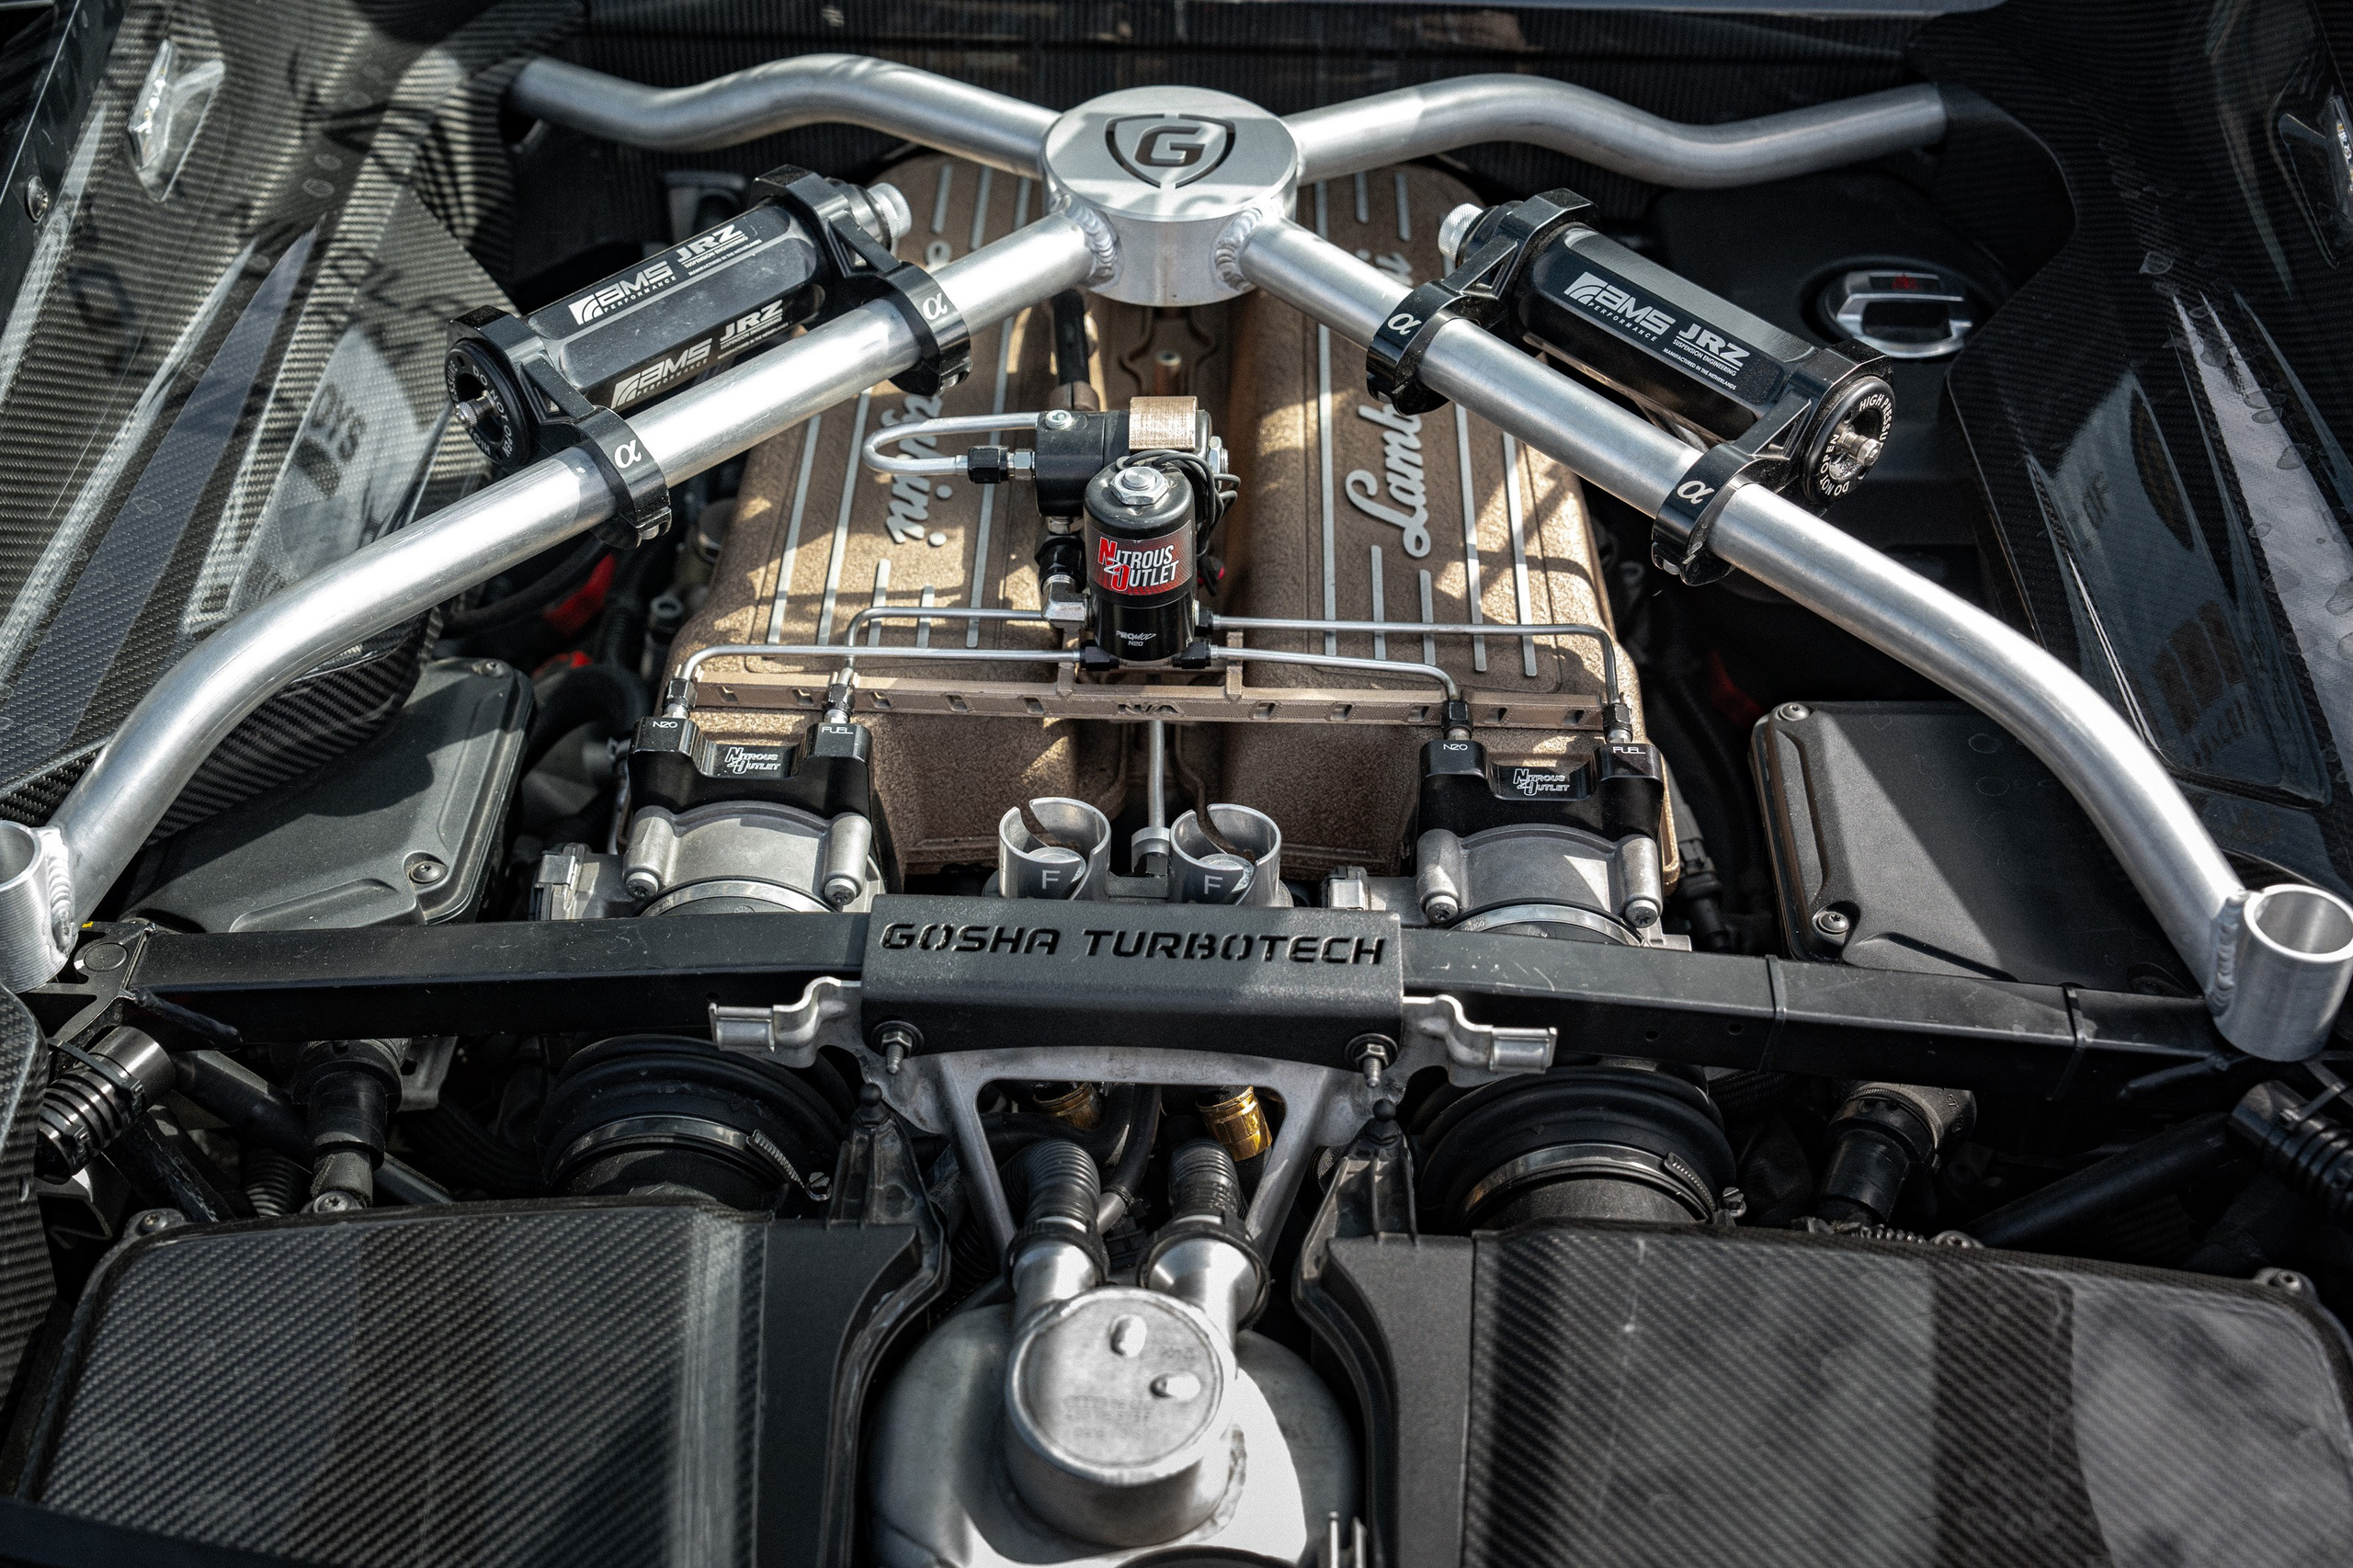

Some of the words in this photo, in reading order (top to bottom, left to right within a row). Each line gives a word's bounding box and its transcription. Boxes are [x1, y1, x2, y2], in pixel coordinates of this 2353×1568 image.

[1133, 125, 1206, 167] G
[676, 223, 743, 263] JRZ
[604, 275, 676, 313] PERFORMANCE
[719, 299, 783, 342] JRZ
[1587, 301, 1658, 342] PERFORMANCE
[1672, 338, 1704, 359] SUSPENSION
[1702, 353, 1737, 377] ENGINEERING
[1677, 323, 1750, 368] JRZ
[637, 358, 708, 396] PERFORMANCE
[472, 365, 488, 386] DO
[489, 389, 509, 422] NOT
[502, 425, 514, 458] OPEN
[1859, 393, 1886, 413] HIGH
[1879, 396, 1893, 449] PRESSU
[1820, 434, 1840, 474] OPEN
[1834, 480, 1850, 496] DO
[1097, 536, 1175, 569] NITROUS
[1110, 560, 1179, 592] OUTLET
[822, 726, 853, 734] FUEL
[1613, 746, 1645, 755] FUEL
[1041, 869, 1061, 890] F
[1203, 875, 1223, 895] F
[880, 922, 1062, 956] GOSHA
[1082, 928, 1385, 965] TURBOTECH
